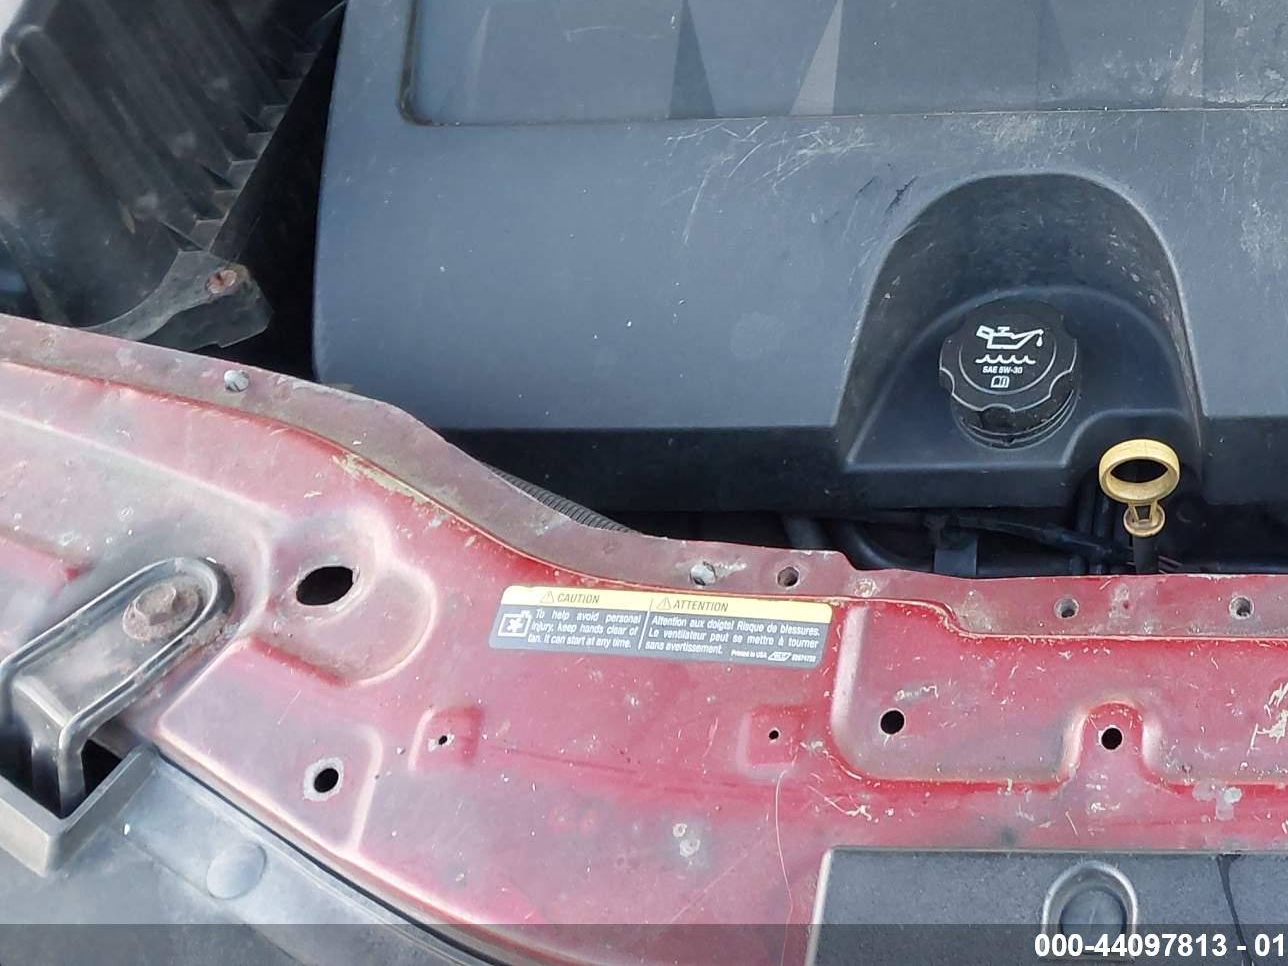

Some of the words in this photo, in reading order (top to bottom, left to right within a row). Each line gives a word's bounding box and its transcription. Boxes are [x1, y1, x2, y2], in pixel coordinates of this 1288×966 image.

[982, 366, 998, 374] SAE
[998, 366, 1023, 374] 5W-30
[557, 593, 600, 604] CAUTION
[673, 601, 729, 612] ATTENTION
[535, 609, 545, 619] To
[552, 610, 570, 622] help
[576, 611, 600, 622] avoid
[605, 613, 642, 625] personal
[557, 622, 577, 634] keep
[580, 623, 604, 634] hands
[607, 624, 627, 635] clear
[629, 625, 639, 636] of
[652, 615, 688, 627] Attention
[690, 619, 705, 628] aux
[737, 620, 765, 634] Risque
[767, 622, 777, 633] de
[780, 623, 821, 636] blessures.
[550, 636, 566, 645] can
[567, 635, 585, 646] start
[586, 636, 595, 646] at
[596, 638, 611, 649] any
[612, 638, 631, 648] time.
[648, 628, 660, 638] Le
[663, 629, 706, 641] ventilateur
[709, 631, 729, 643] peut
[732, 634, 743, 643] se
[747, 634, 775, 645] mettre
[778, 635, 784, 646] à
[788, 637, 819, 648] tourner
[645, 641, 664, 651] sans
